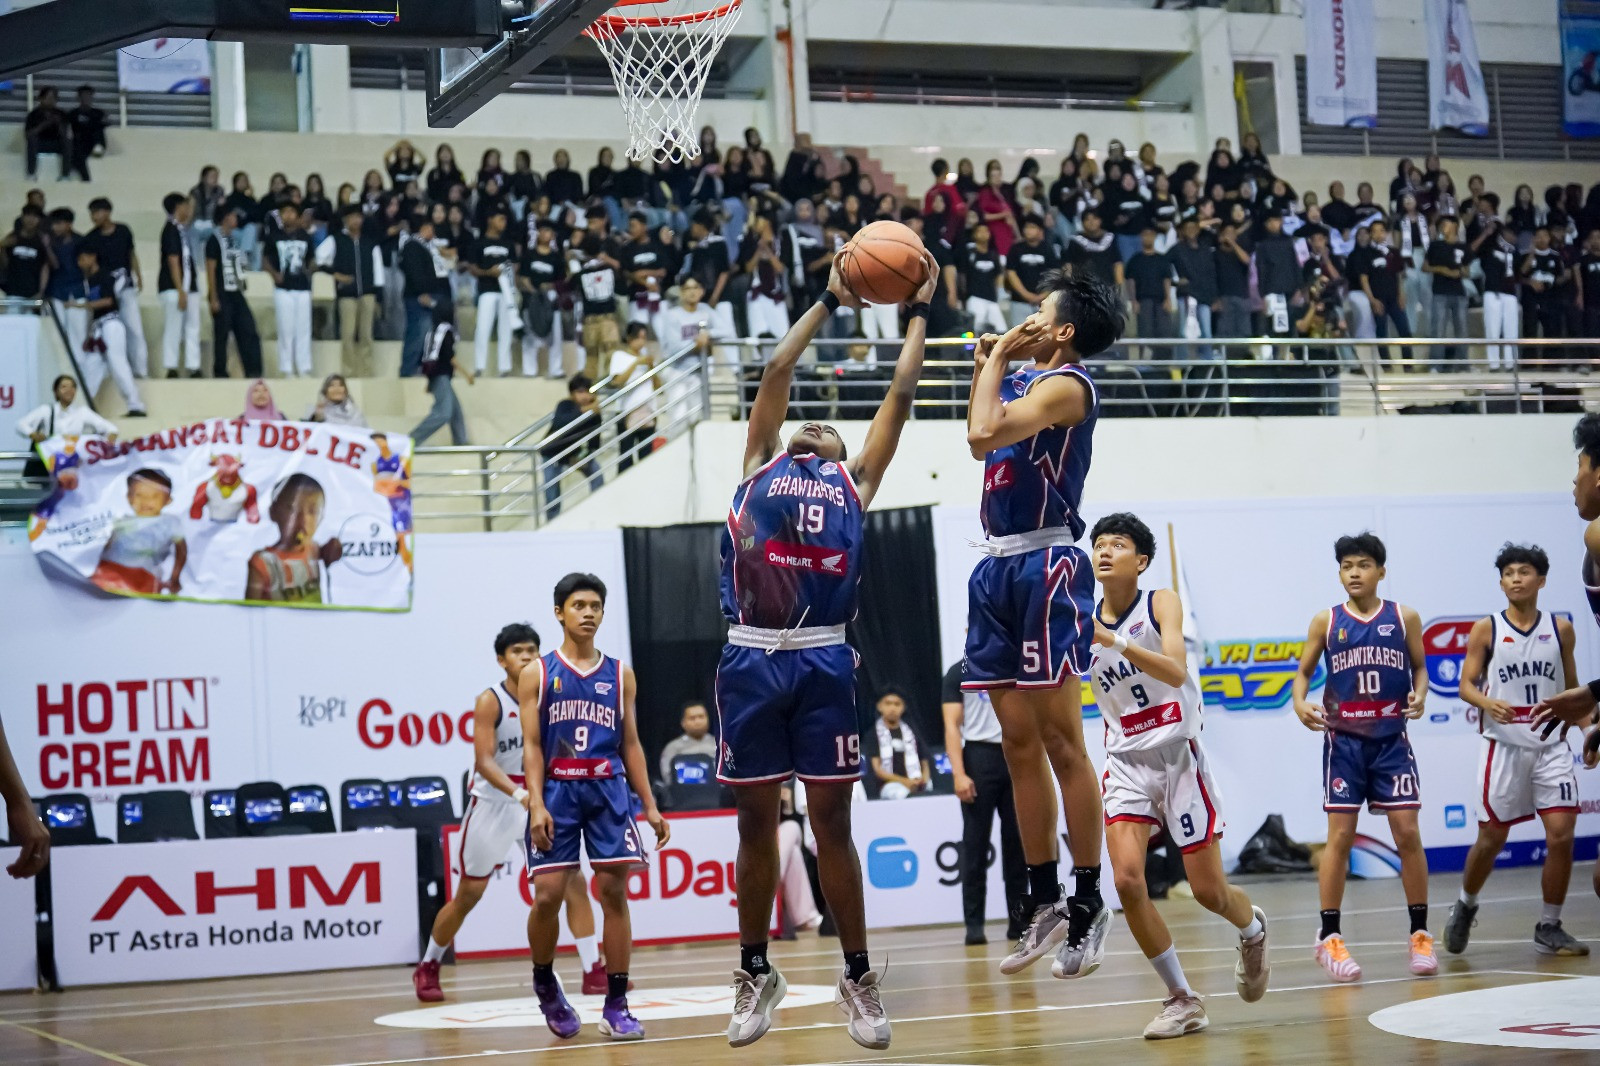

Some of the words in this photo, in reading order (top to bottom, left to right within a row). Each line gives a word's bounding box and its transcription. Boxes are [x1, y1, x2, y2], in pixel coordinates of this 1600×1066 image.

[1332, 0, 1345, 90] HONDA
[259, 423, 318, 454] DBL
[331, 436, 366, 469] LE
[767, 475, 849, 514] BHAWIKARS
[370, 522, 380, 538] 9
[796, 502, 824, 533] 19
[342, 541, 400, 557] ZAFIN
[769, 552, 786, 563] One
[786, 555, 813, 568] HEART.
[1022, 640, 1041, 673] 5
[1220, 644, 1250, 663] YA
[1331, 645, 1404, 674] BHAWIKARSU
[1357, 670, 1381, 694] 10
[1499, 660, 1555, 683] SMANEL
[1130, 683, 1150, 708] 9
[1525, 684, 1539, 704] 11
[1342, 709, 1355, 718] One
[575, 726, 589, 752] 9
[1122, 725, 1135, 735] One
[39, 737, 211, 789] CREAM
[835, 734, 861, 767] 19
[1392, 773, 1413, 797] 10
[1559, 782, 1572, 801] 11
[1180, 812, 1195, 838] 9
[624, 828, 637, 852] 5
[91, 861, 381, 922] AHM
[89, 931, 119, 953] PT
[129, 930, 199, 952] Astra
[208, 919, 293, 946] Honda
[303, 918, 382, 940] Motor
